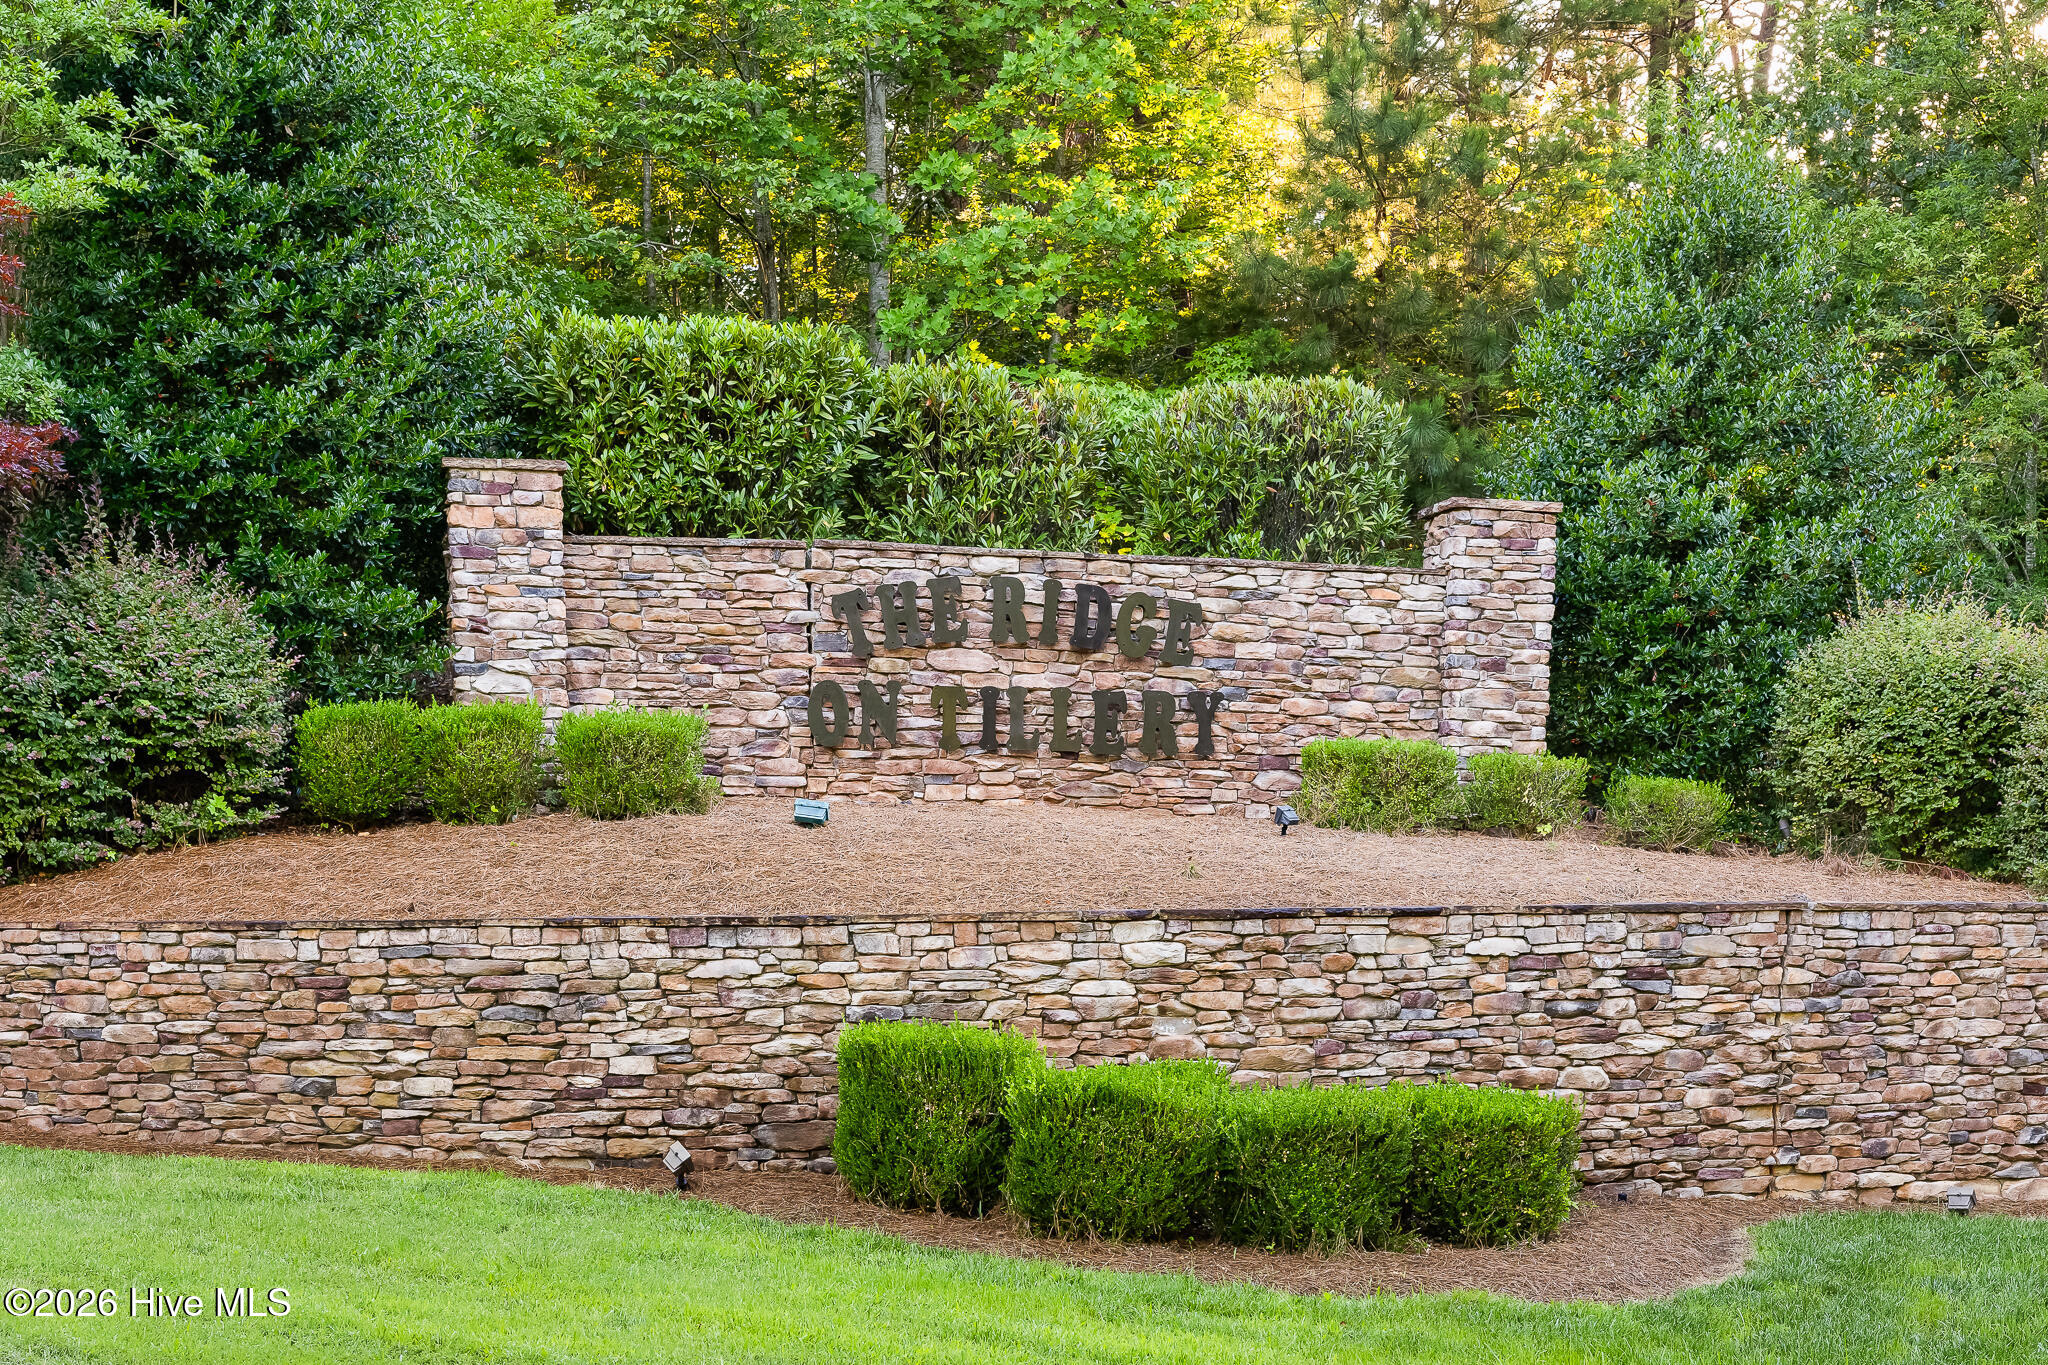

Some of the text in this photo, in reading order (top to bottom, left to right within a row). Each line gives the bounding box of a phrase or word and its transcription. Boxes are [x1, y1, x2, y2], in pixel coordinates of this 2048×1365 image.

[832, 576, 1203, 666] THE RIDGE
[807, 680, 1223, 756] ON TILLERY
